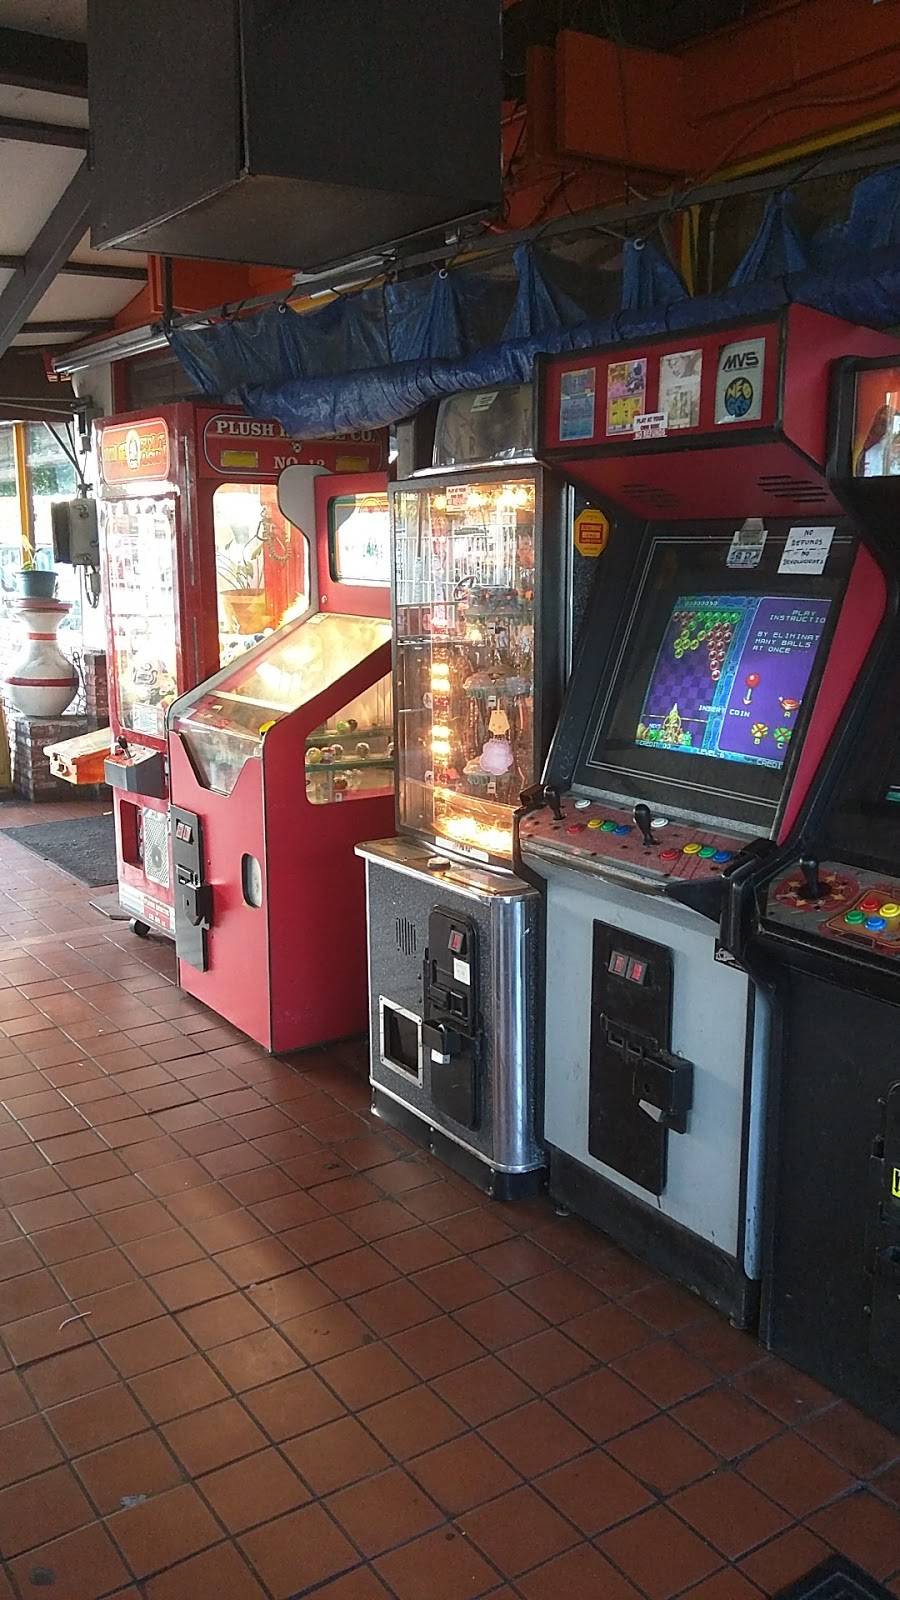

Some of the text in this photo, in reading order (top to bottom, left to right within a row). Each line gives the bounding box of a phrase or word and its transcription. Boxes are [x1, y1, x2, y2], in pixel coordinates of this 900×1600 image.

[723, 352, 759, 369] MVS
[216, 419, 274, 436] PLUSH
[804, 529, 814, 537] NO
[770, 614, 826, 624] INSTRUCTIO
[772, 632, 820, 641] ELIMINAT
[768, 646, 791, 654] ONCE
[699, 704, 751, 718] INSERT COIN
[777, 742, 784, 750] C
